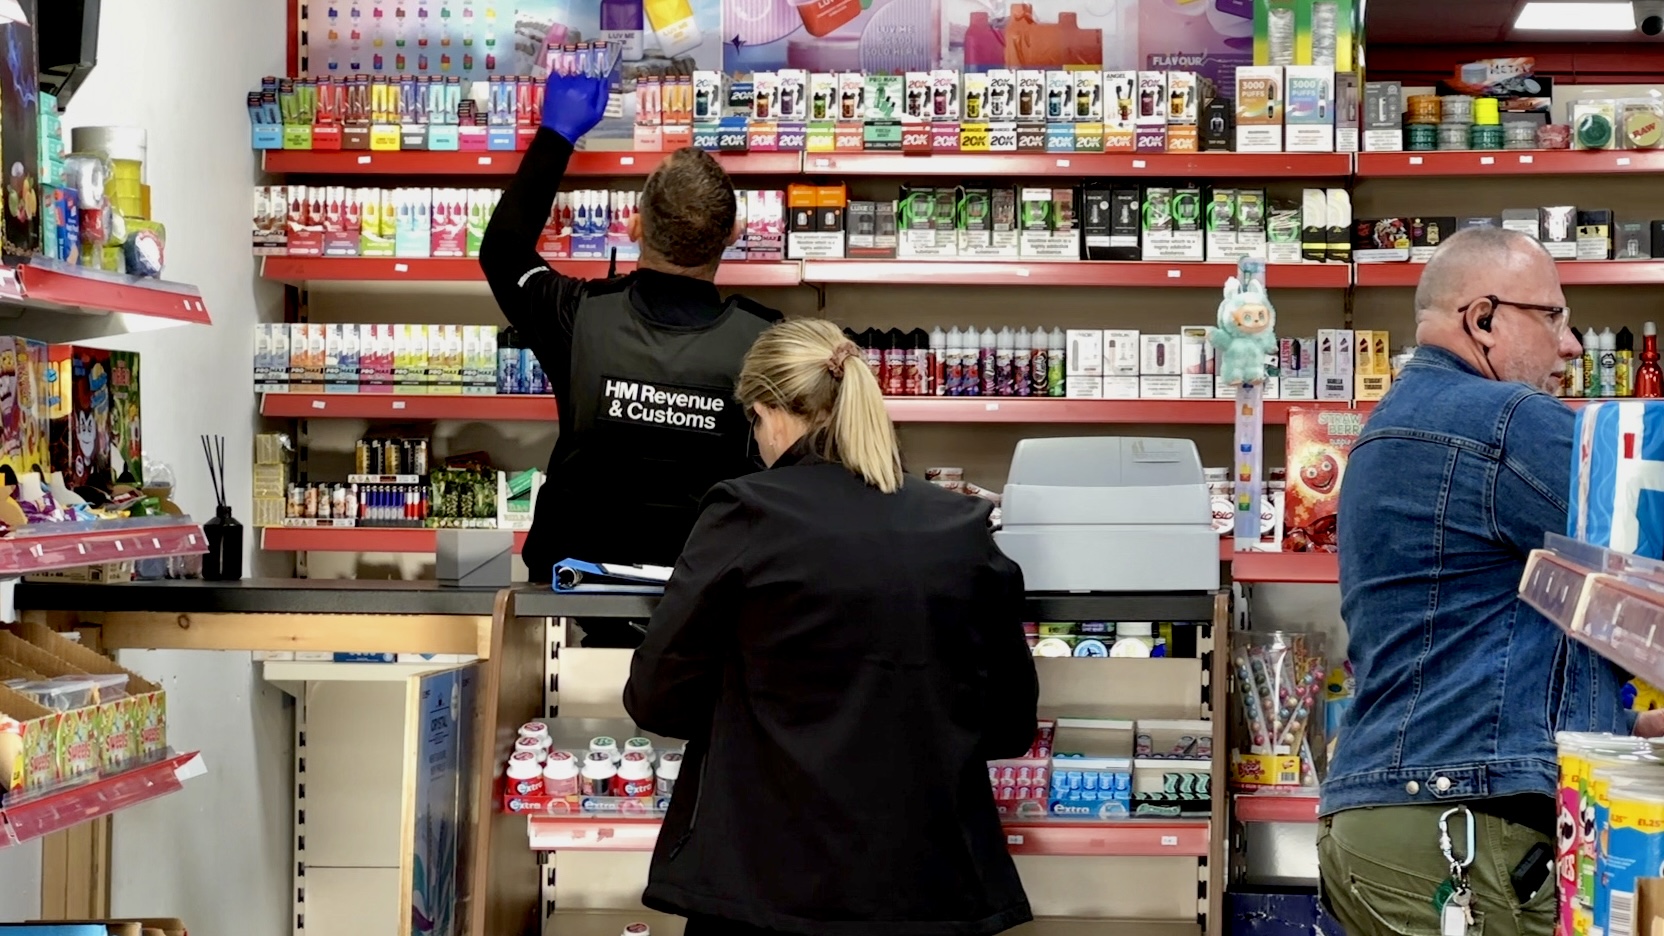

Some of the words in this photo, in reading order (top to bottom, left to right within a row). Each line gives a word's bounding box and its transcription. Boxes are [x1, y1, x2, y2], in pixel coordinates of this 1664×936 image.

[1152, 56, 1202, 66] FLAVOUR
[1242, 81, 1264, 90] 3000
[1293, 81, 1316, 89] 3000
[1242, 90, 1265, 98] PUFFS
[1292, 89, 1316, 97] PUFFS
[1632, 123, 1656, 138] RAW
[694, 135, 719, 146] 20K
[720, 135, 746, 146] 20K
[751, 135, 778, 146] 20K
[779, 135, 805, 146] 20K
[837, 136, 862, 147] 20K
[903, 134, 928, 145] 20K
[933, 135, 959, 146] 20K
[962, 136, 986, 146] 20K
[990, 136, 1014, 146] 20K
[1018, 136, 1044, 147] 20K
[1047, 136, 1073, 147] 20K
[1076, 136, 1101, 147] 20K
[1106, 136, 1132, 147] 20K
[1138, 136, 1164, 147] 20K
[1169, 138, 1196, 149] 20K
[1281, 340, 1290, 364] NASTY
[605, 380, 639, 401] HM
[640, 384, 724, 412] Revenue
[608, 399, 623, 418] &
[626, 402, 716, 429] Customs
[1318, 412, 1363, 425] STRAW
[516, 781, 543, 794] extra
[624, 782, 652, 794] extra
[509, 799, 541, 811] extra
[584, 799, 616, 810] extra
[1053, 803, 1090, 814] extra
